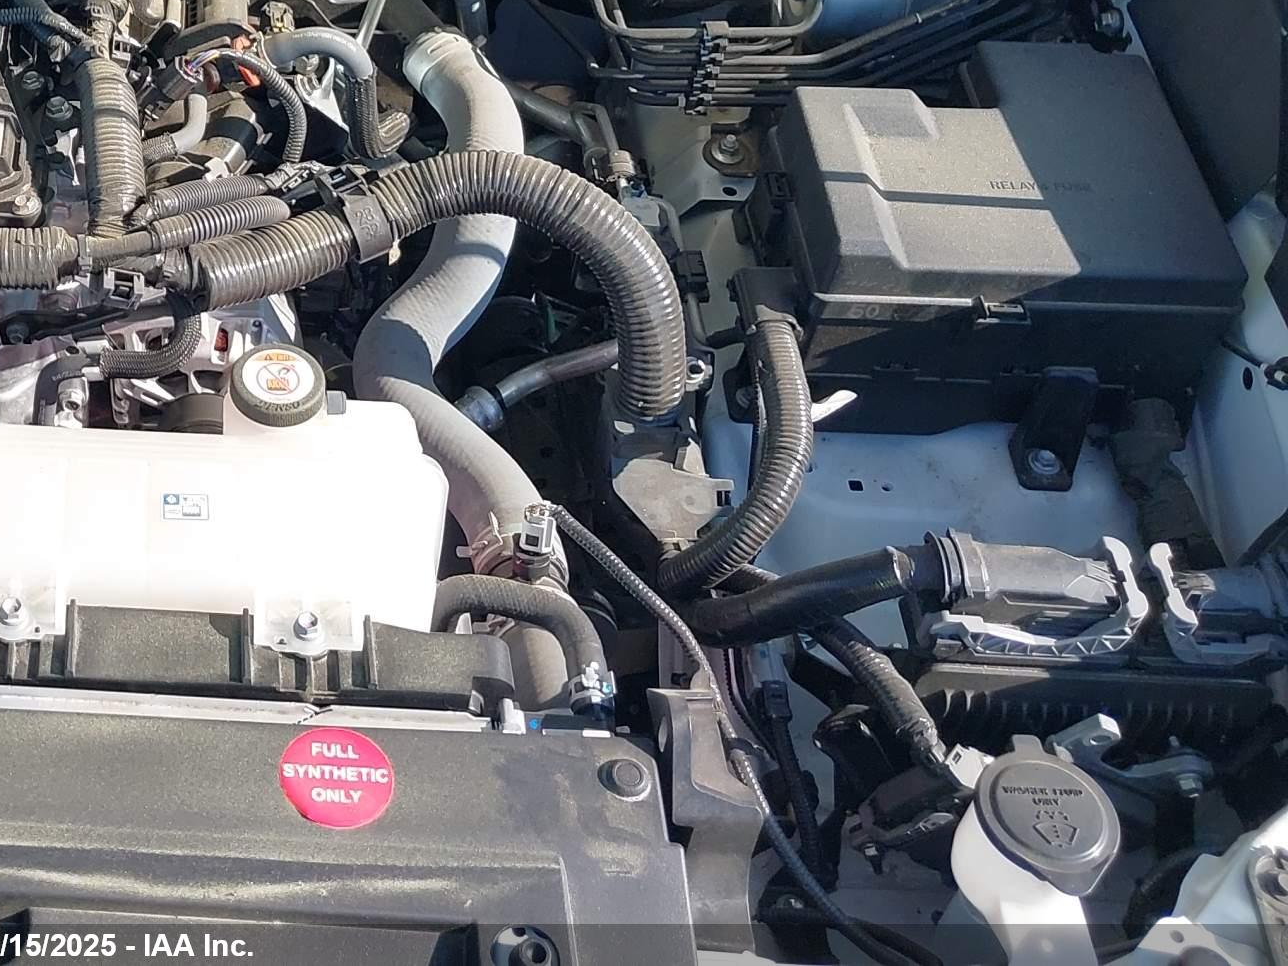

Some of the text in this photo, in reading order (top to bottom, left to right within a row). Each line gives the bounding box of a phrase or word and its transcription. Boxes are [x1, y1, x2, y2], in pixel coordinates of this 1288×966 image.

[989, 180, 1036, 191] RELAY
[311, 742, 359, 759] FULL
[283, 764, 388, 783] SYNTHETIC
[311, 788, 362, 803] ONLY
